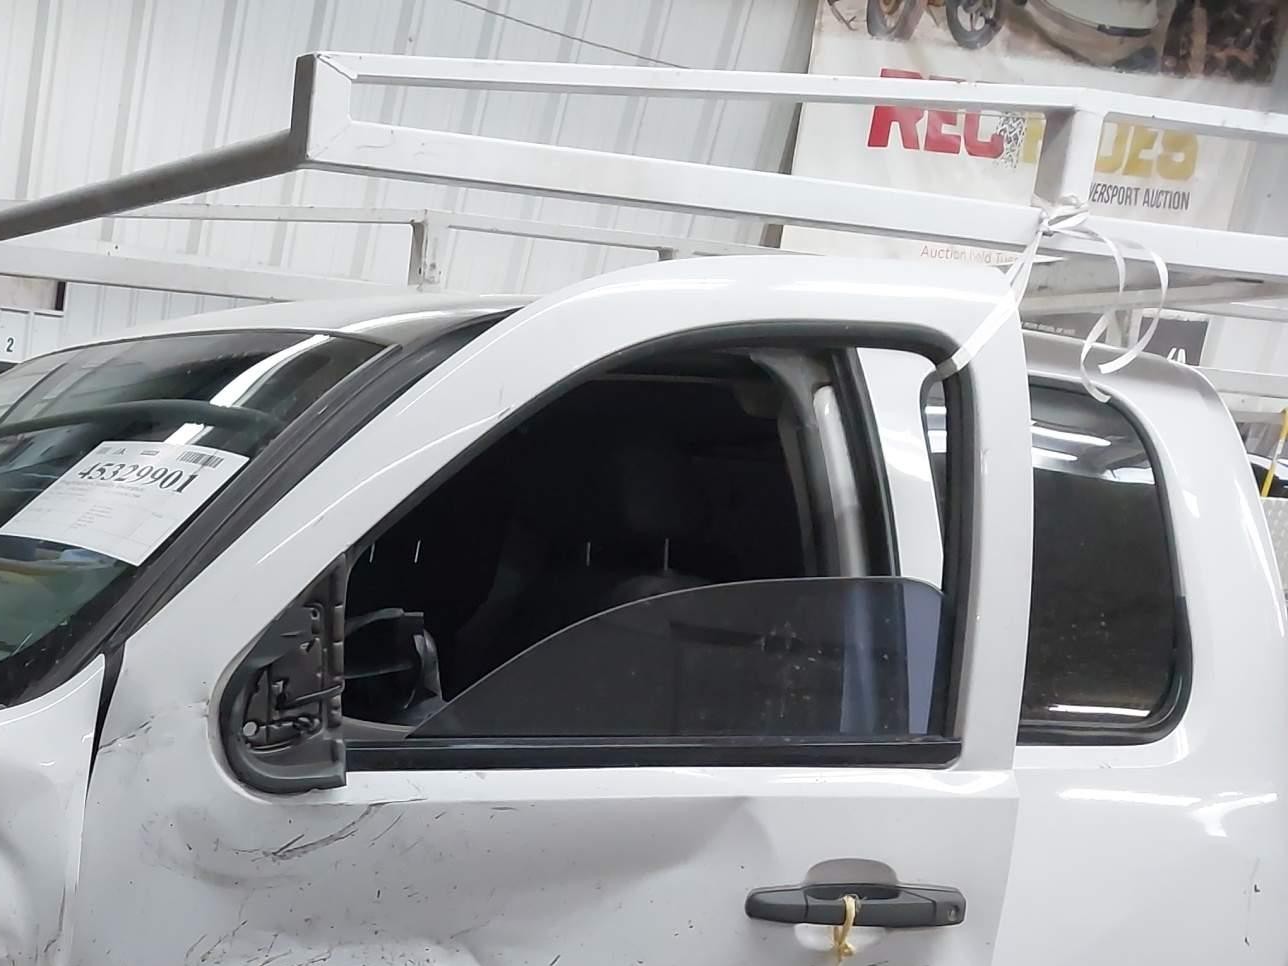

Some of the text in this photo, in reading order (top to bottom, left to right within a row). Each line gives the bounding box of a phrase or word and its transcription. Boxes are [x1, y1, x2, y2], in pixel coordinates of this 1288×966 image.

[1142, 187, 1191, 211] AUCTION
[6, 337, 14, 352] 2
[78, 462, 198, 494] 45329901
